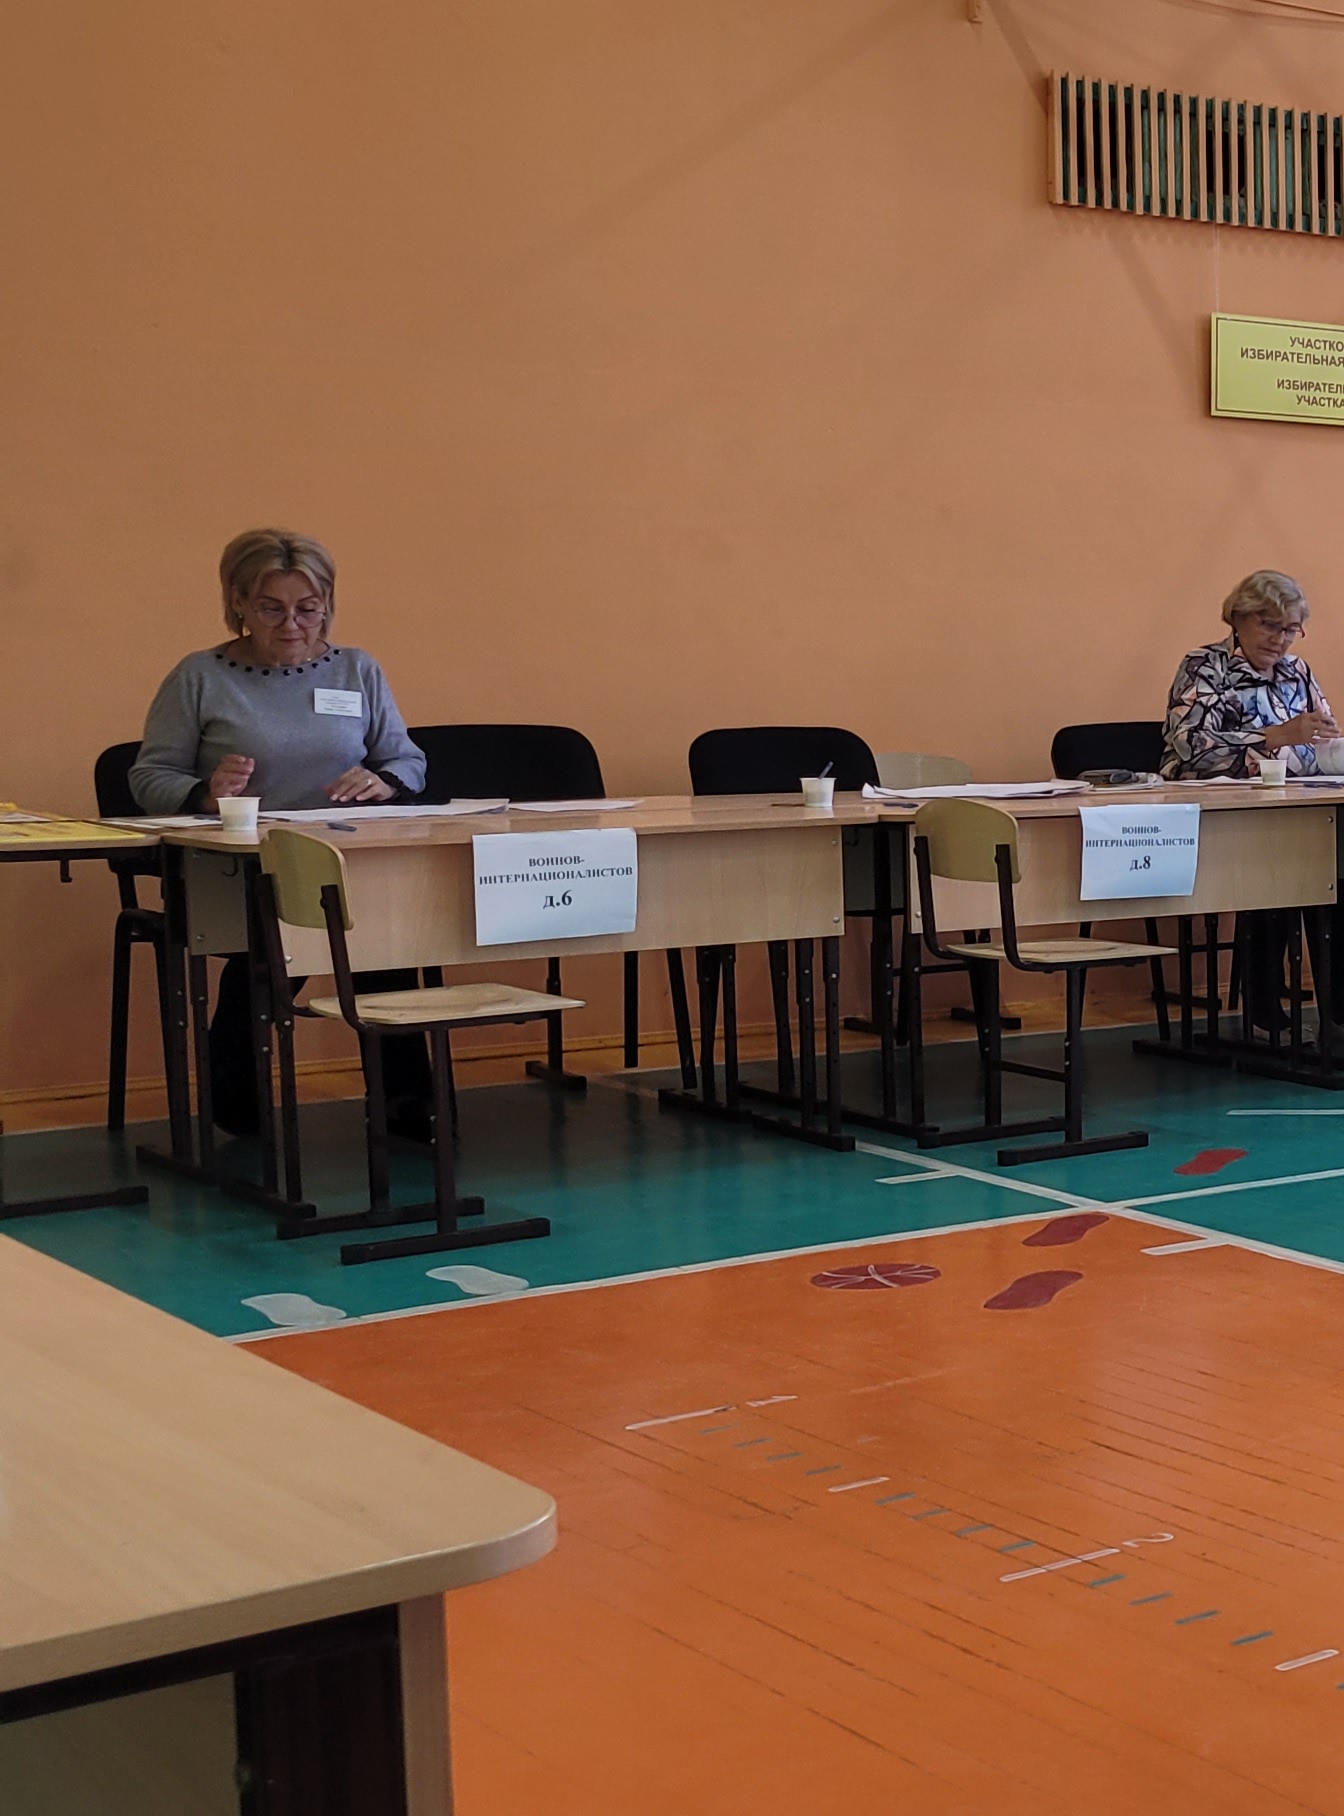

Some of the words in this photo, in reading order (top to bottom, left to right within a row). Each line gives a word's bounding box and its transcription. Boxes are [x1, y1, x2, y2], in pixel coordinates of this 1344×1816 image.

[1121, 826, 1162, 835] ВОИНОВ-
[1085, 838, 1196, 848] ИНТЕРНАЦИОНАЛИСТОВ
[528, 855, 585, 868] ВОИНОВ-
[1129, 855, 1152, 872] д.8
[479, 866, 634, 886] ИНТЕРНАЦИОНАЛИСТОВ
[542, 889, 573, 910] д.6
